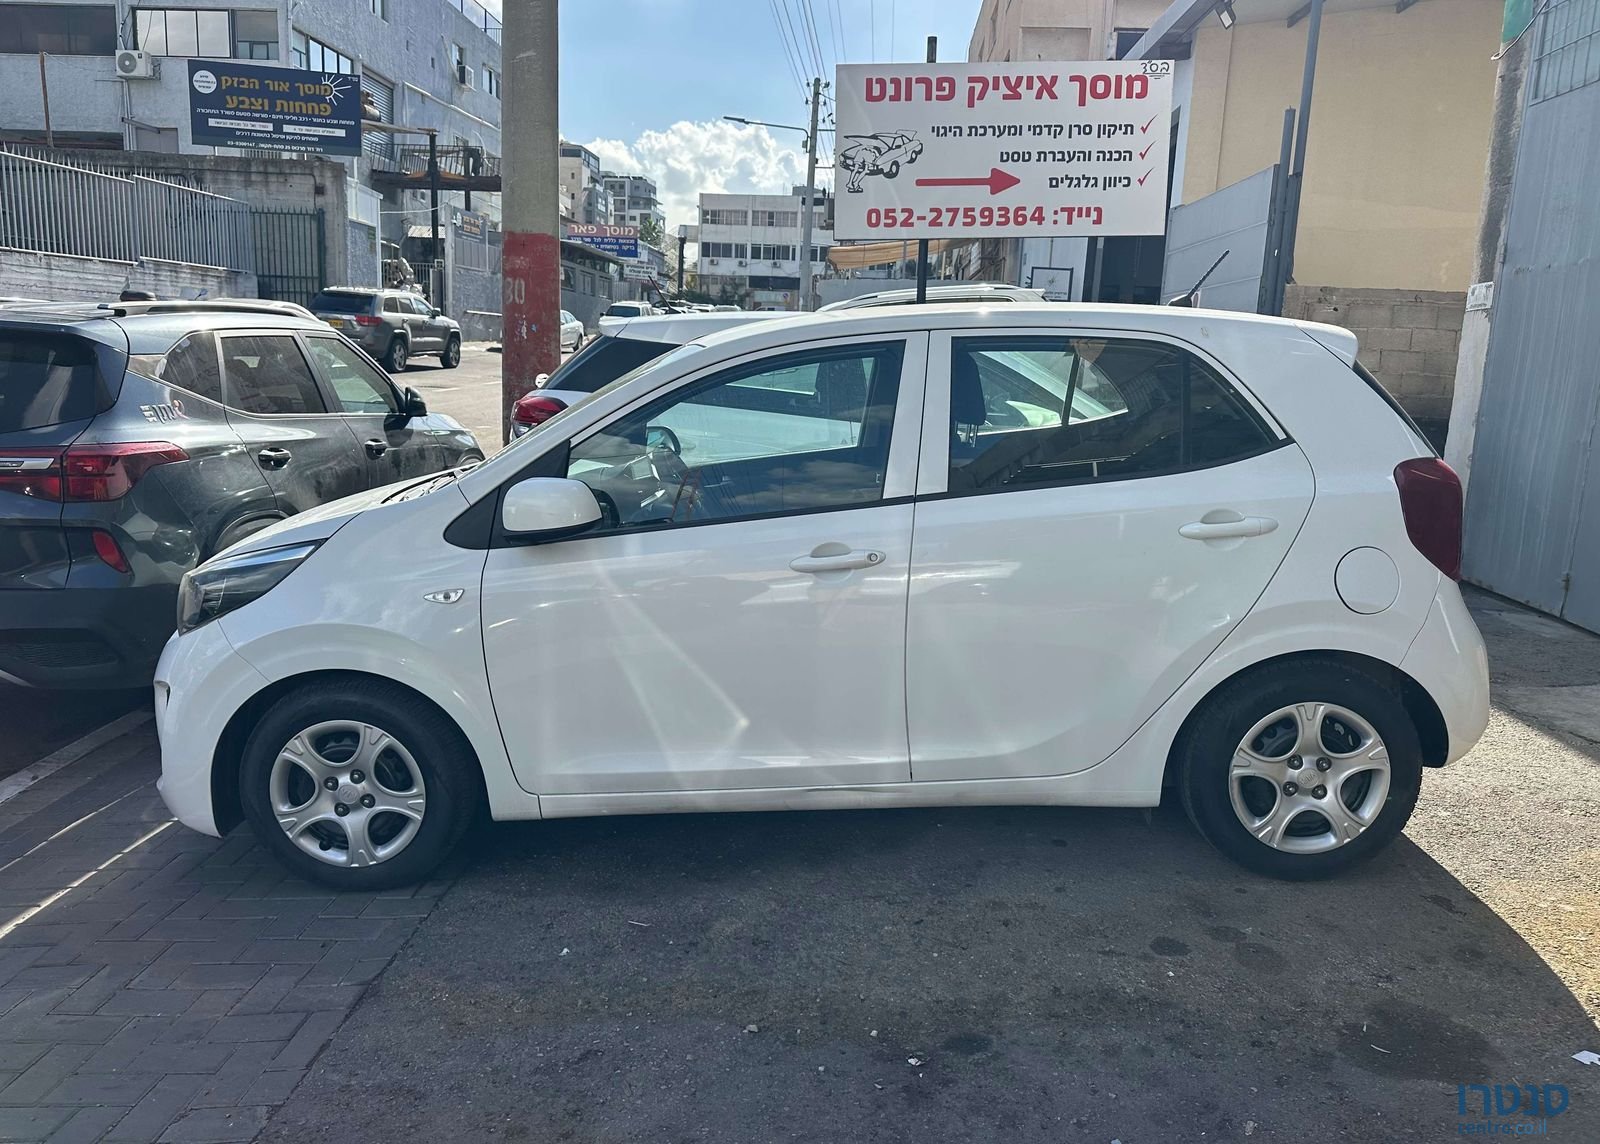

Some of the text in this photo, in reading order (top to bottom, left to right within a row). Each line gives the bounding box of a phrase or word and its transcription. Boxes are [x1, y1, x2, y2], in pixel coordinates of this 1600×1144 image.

[221, 76, 331, 96] מוסך אור הבזק
[865, 74, 1149, 108] מוסך איציק פרונט
[225, 95, 332, 116] פחחות וצבע
[931, 123, 1134, 139] תיקון סרן קדמי ומערכת היגוי
[999, 150, 1133, 164] הכנה והעברת טסט
[1048, 174, 1131, 190] כיוון גלגלים
[866, 206, 1103, 228] נייד: 052-2759364
[571, 224, 634, 237] מוסך פאר
